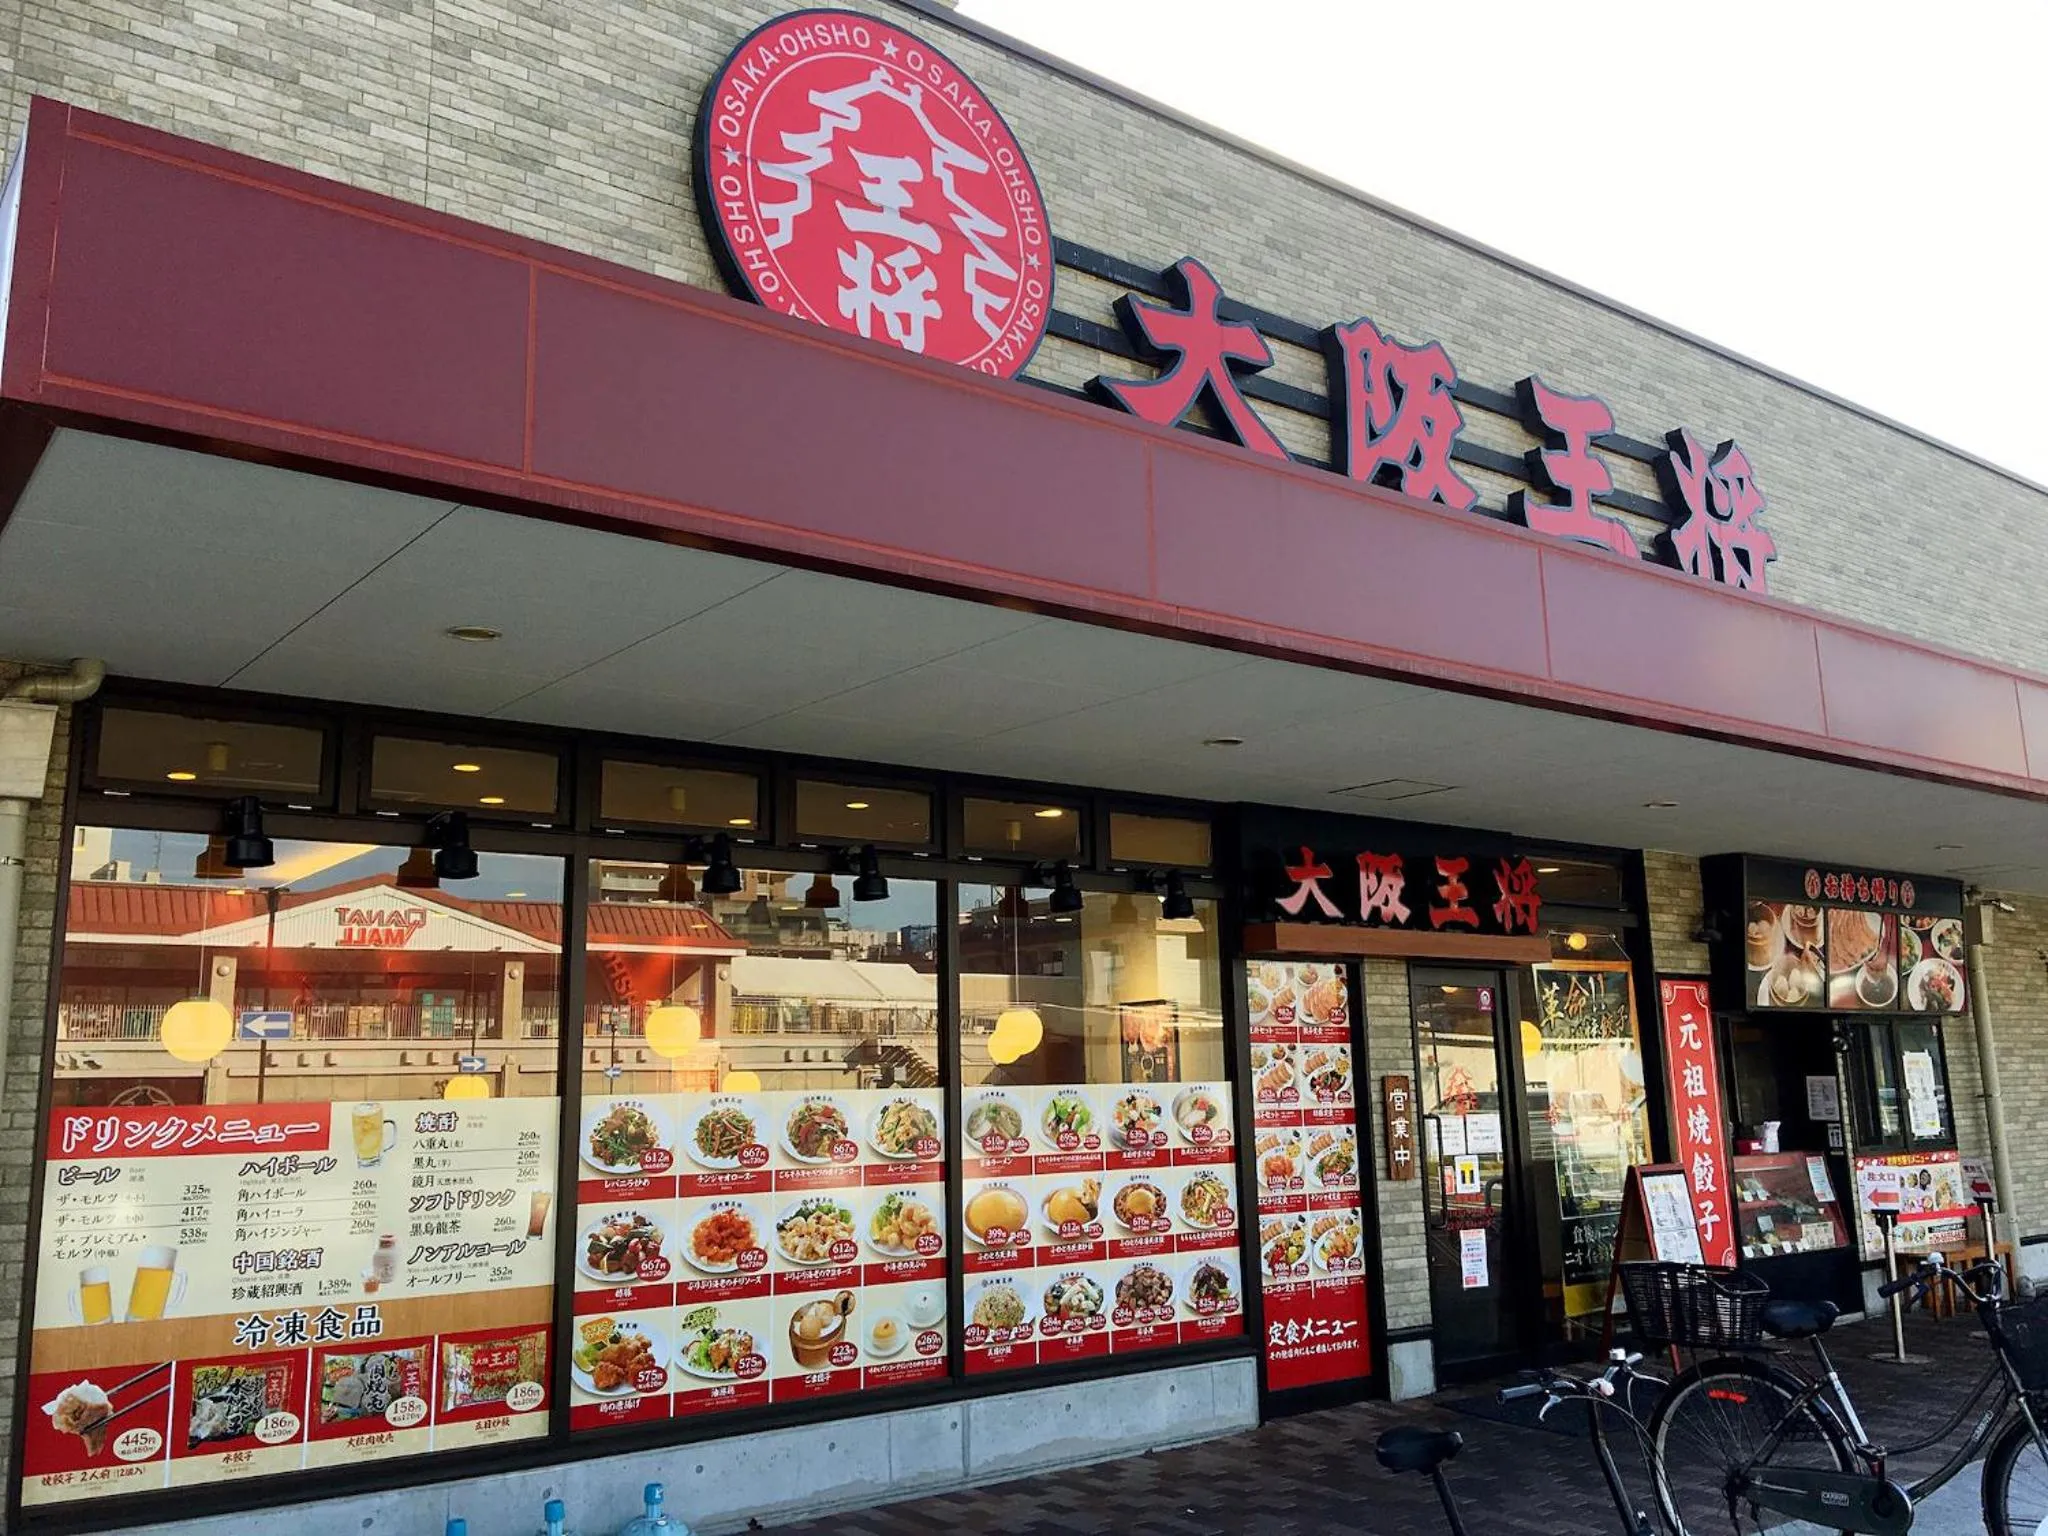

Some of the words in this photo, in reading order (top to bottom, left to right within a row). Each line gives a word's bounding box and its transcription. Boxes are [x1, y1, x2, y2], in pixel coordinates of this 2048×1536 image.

[1088, 255, 1777, 595] 大阪王将
[1275, 845, 1542, 936] 大阪王将
[1824, 872, 1899, 906] お持ち帰り
[415, 1110, 460, 1134] 焼酎
[1388, 1087, 1412, 1169] 営業中
[62, 1115, 321, 1153] ドリンクメニュー
[518, 1130, 541, 1141] 260円
[517, 1150, 540, 1160] 260円
[239, 1154, 337, 1177] ハイボール
[59, 1165, 121, 1186] ビール
[183, 1184, 211, 1196] 325円
[352, 1179, 377, 1190] 260円
[56, 1192, 118, 1207] ザ・モルツ
[238, 1187, 307, 1202] 角ハイボール
[408, 1188, 517, 1213] ソフトドリンク
[181, 1206, 209, 1217] 417円
[351, 1200, 377, 1211] 260円
[236, 1207, 305, 1223] 角ハイコーラ
[350, 1219, 375, 1230] 260円
[409, 1219, 461, 1237] 黒烏龍茶
[179, 1228, 209, 1240] 538円
[234, 1225, 323, 1242] 角ハイジンジャー
[406, 1239, 528, 1265] ノンアルコール
[740, 1250, 765, 1261] 667円
[232, 1247, 324, 1275] 中国銘酒
[641, 1258, 667, 1270] 667円
[489, 1265, 513, 1277] 352円
[317, 1278, 352, 1291] 1,389円
[406, 1271, 477, 1288] オールフリー
[231, 1281, 304, 1301] 珍蔵紹興酒
[233, 1303, 384, 1350] 冷凍食品
[1268, 1317, 1358, 1347] 定食メニュー
[738, 1357, 763, 1369] 575円
[637, 1370, 664, 1383] 575円
[513, 1386, 540, 1400] 186円
[393, 1400, 422, 1415] 158円
[263, 1416, 295, 1431] 186円
[120, 1432, 156, 1446] 445円
[221, 1451, 254, 1465] 水餃子
[41, 1473, 75, 1487] 焼餃子
[79, 1470, 111, 1483] 2人前
